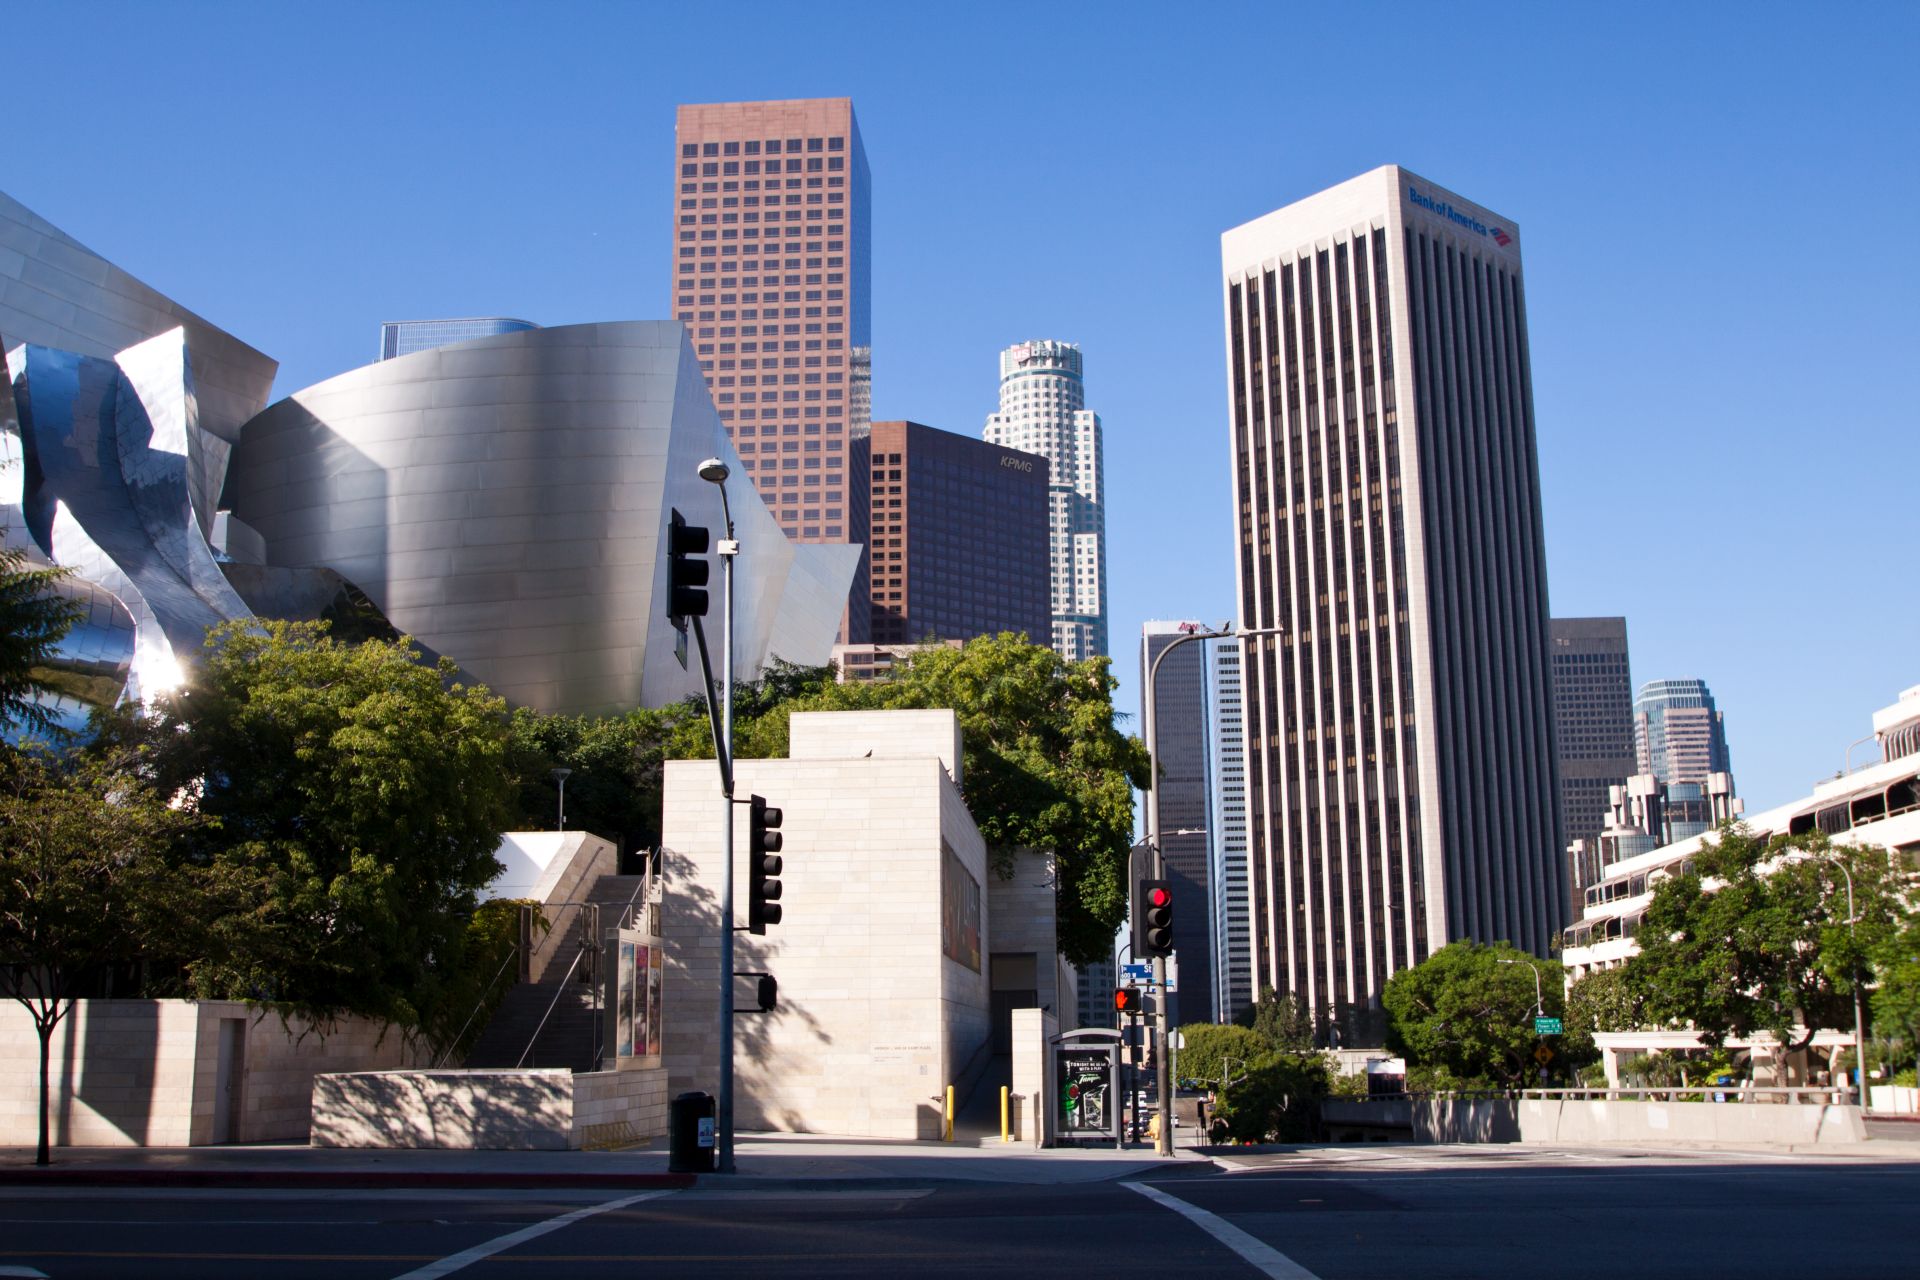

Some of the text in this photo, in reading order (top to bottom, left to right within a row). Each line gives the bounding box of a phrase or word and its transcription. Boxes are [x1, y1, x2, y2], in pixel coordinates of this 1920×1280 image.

[1409, 186, 1488, 236] Bank of America
[1000, 456, 1033, 473] KPMG
[1143, 964, 1152, 973] St
